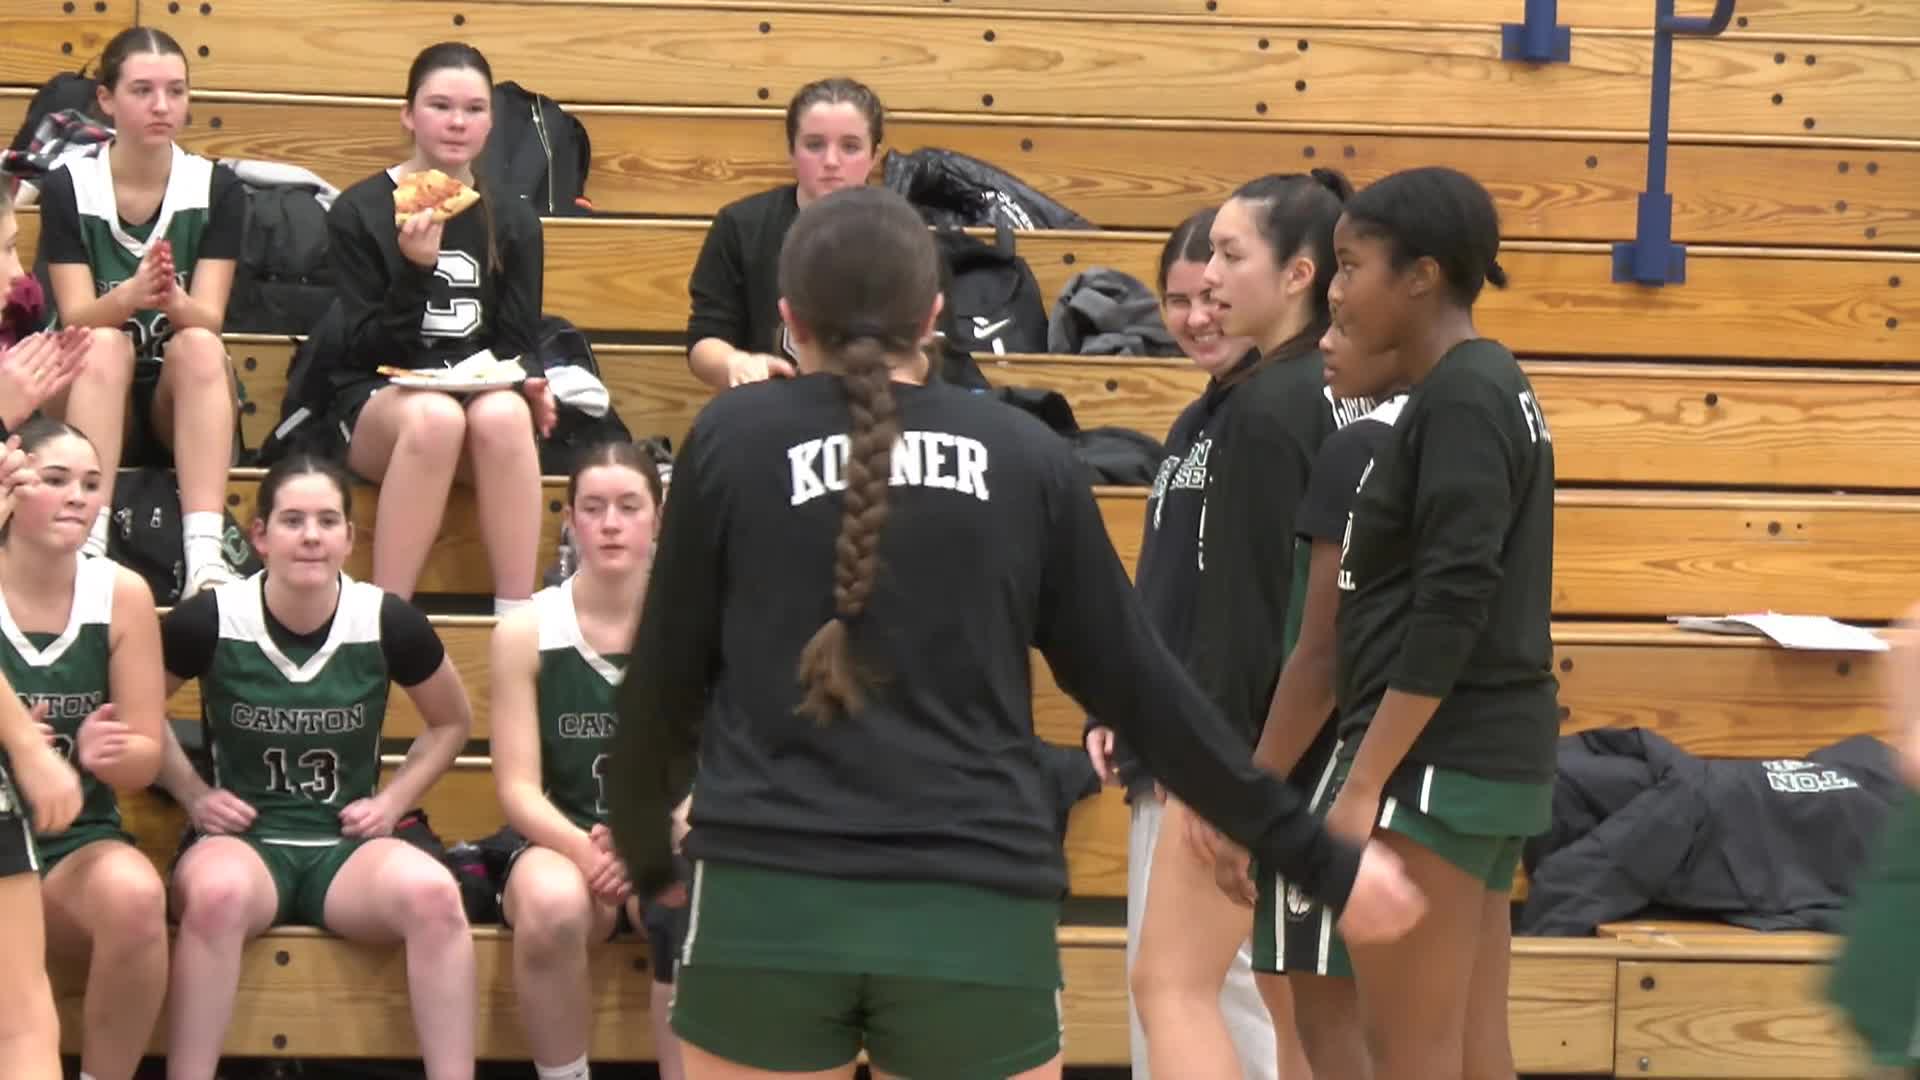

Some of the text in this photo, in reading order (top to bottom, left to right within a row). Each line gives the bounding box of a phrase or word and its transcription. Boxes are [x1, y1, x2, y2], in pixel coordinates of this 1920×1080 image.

[420, 250, 482, 337] C
[787, 431, 990, 506] KONER
[231, 702, 366, 735] CANTON
[263, 747, 339, 804] 13
